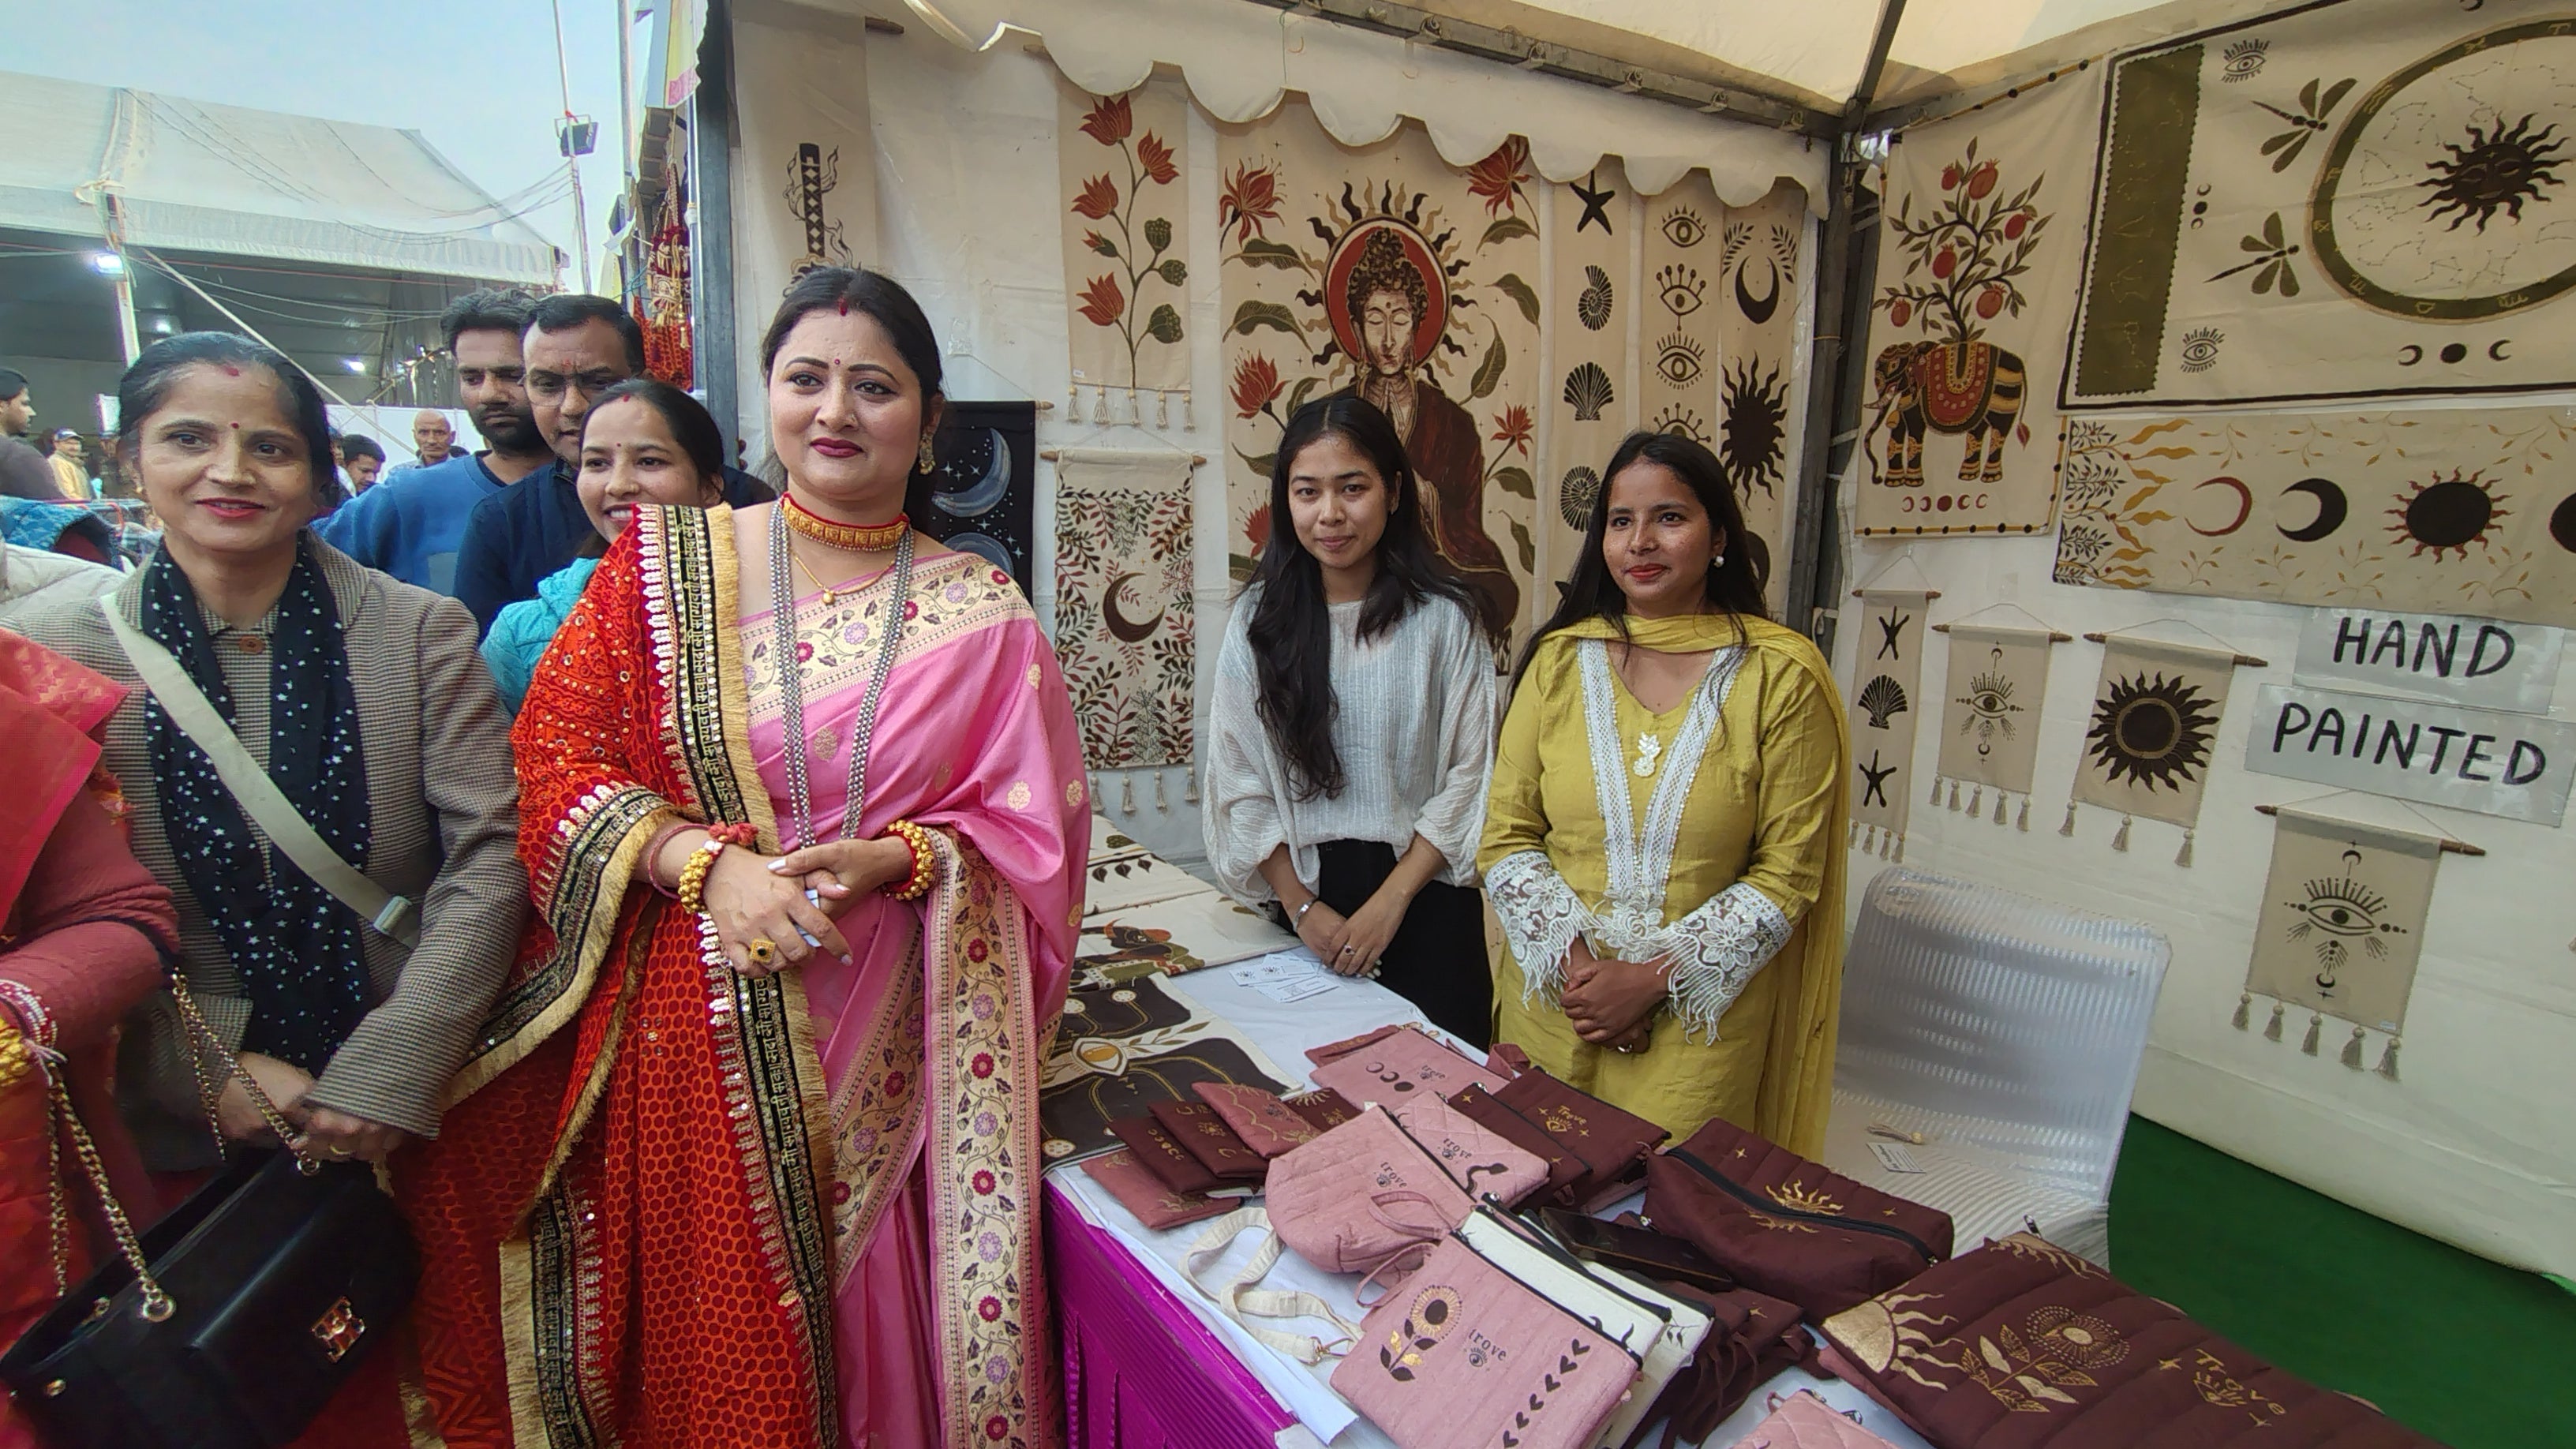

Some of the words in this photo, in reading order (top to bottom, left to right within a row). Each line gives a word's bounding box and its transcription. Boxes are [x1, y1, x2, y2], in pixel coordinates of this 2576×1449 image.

[2332, 616, 2516, 678] HAND
[2272, 702, 2547, 786] PAINTED
[1443, 1138, 1473, 1159] trove
[1380, 1162, 1408, 1188] trove
[1469, 1328, 1507, 1361] trove
